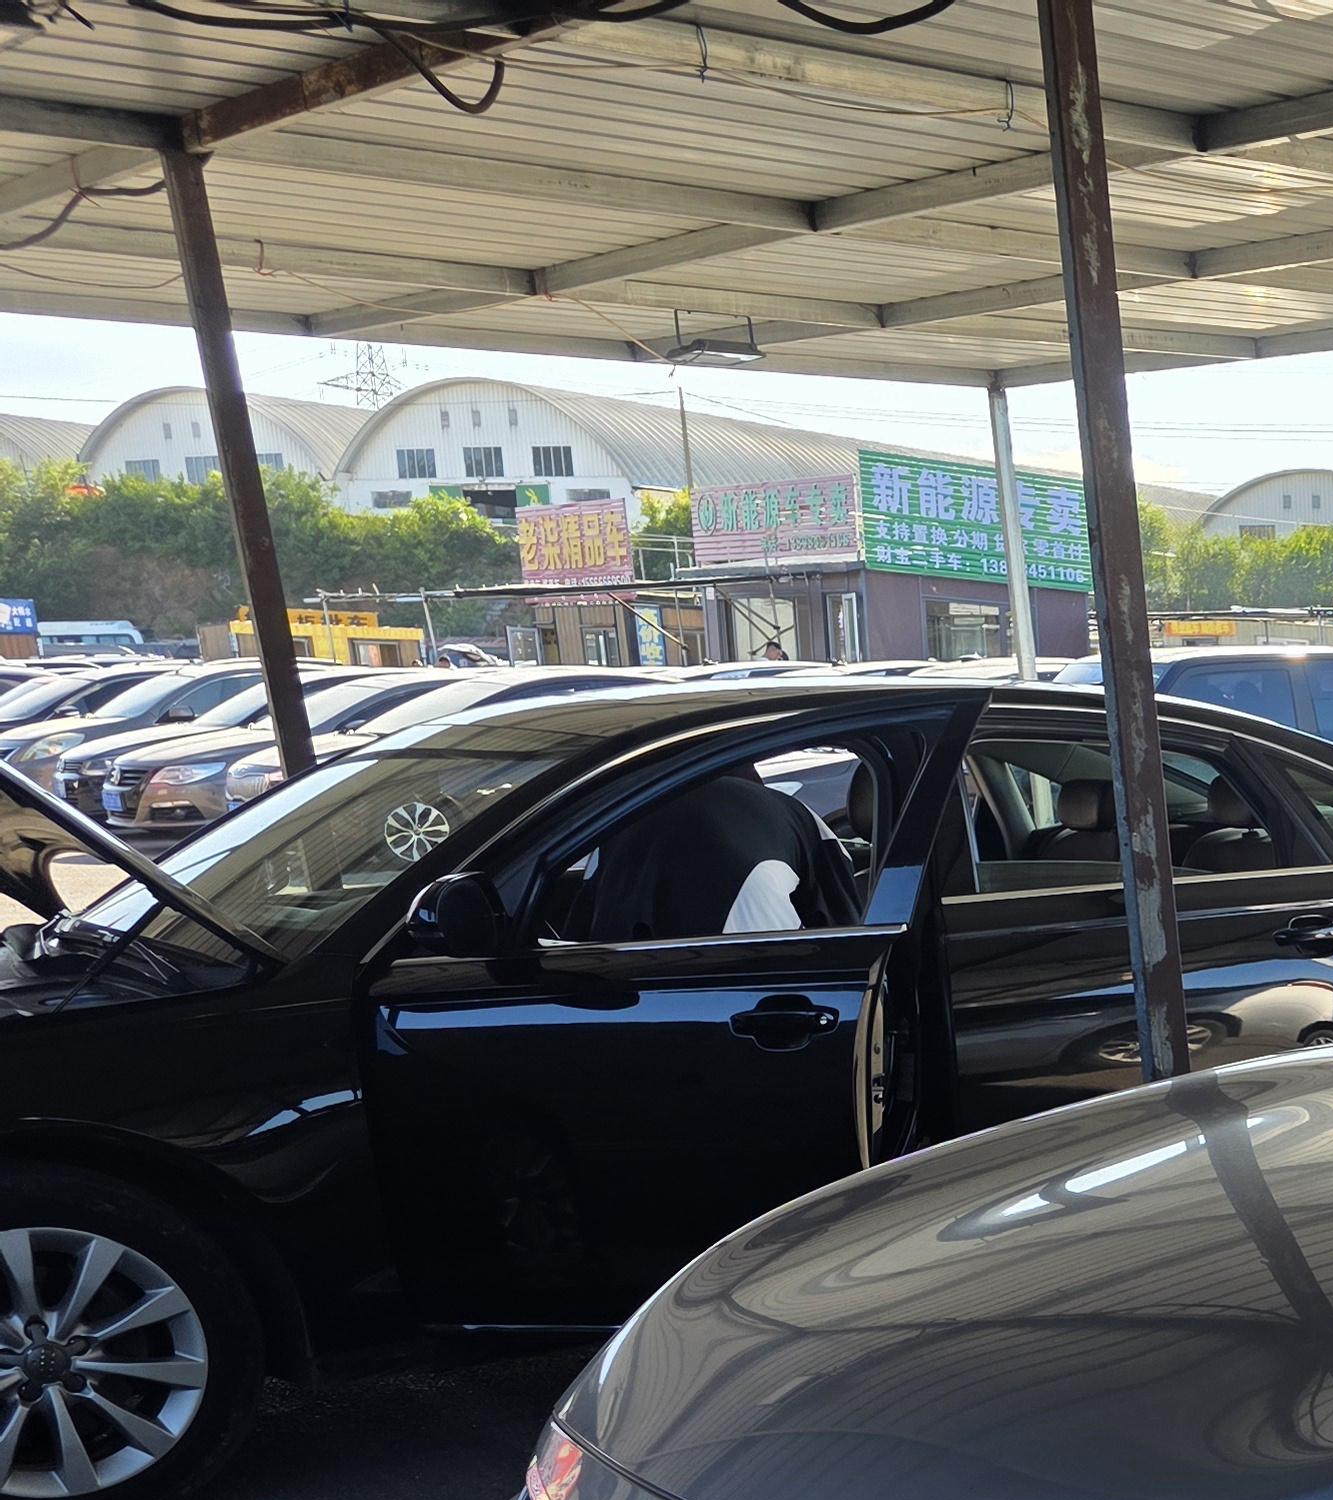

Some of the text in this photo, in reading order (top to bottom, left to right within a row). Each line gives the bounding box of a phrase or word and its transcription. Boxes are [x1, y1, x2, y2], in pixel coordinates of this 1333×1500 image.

[871, 462, 1082, 536] 新能源专卖
[981, 558, 1085, 583] 138451106
